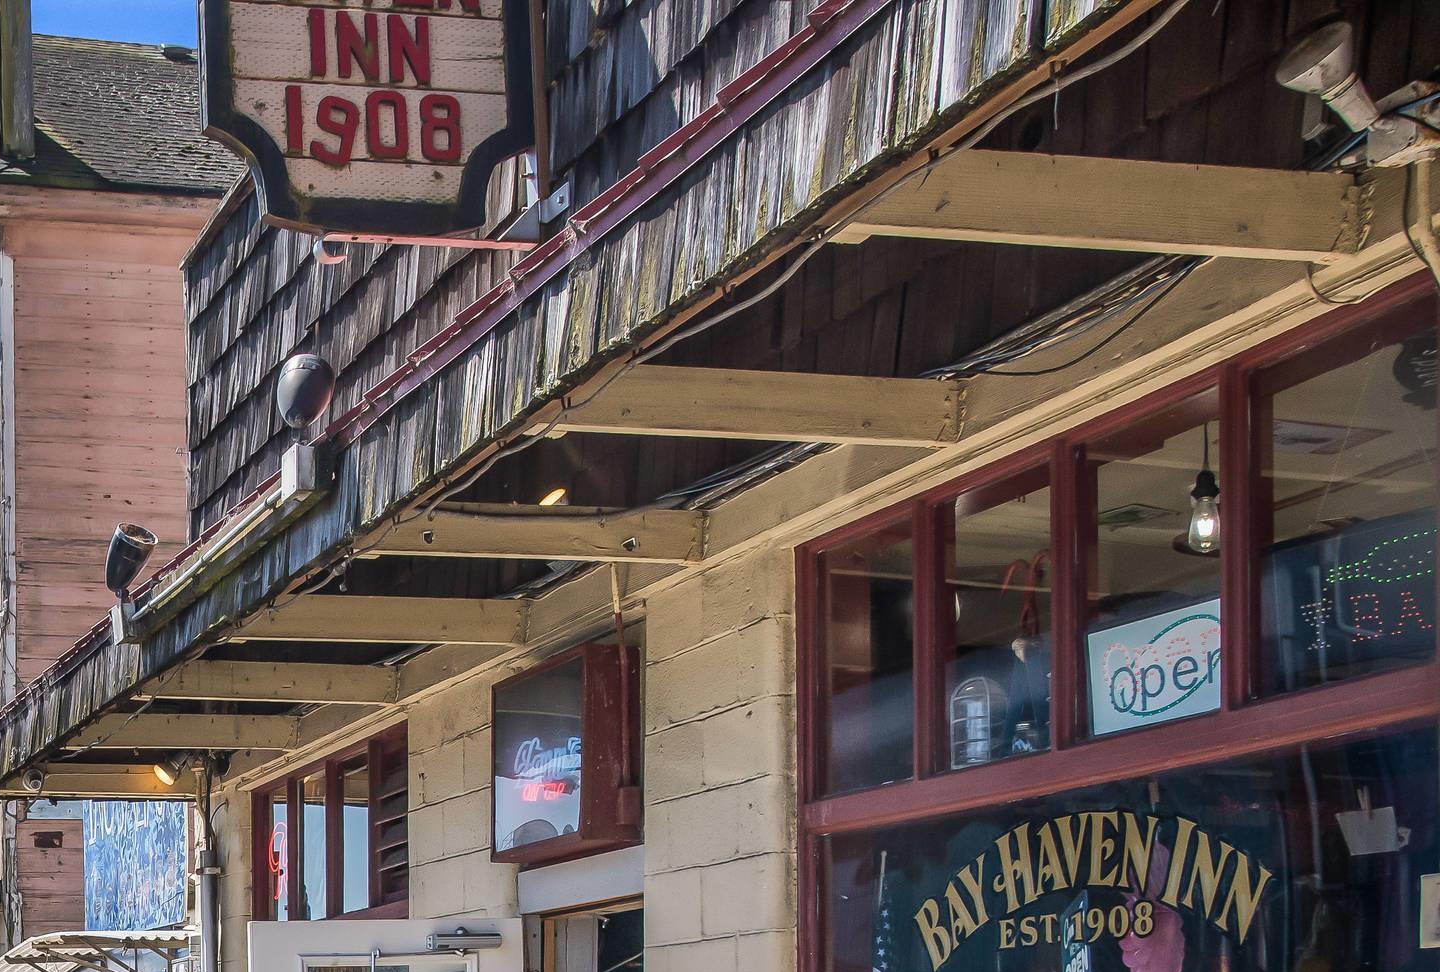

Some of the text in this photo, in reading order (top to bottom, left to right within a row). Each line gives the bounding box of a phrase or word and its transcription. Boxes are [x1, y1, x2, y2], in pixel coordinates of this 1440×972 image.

[309, 8, 430, 85] INN
[285, 86, 461, 166] 1908
[914, 811, 1272, 972] BAY HAVEN INN
[1073, 901, 1154, 942] 1908
